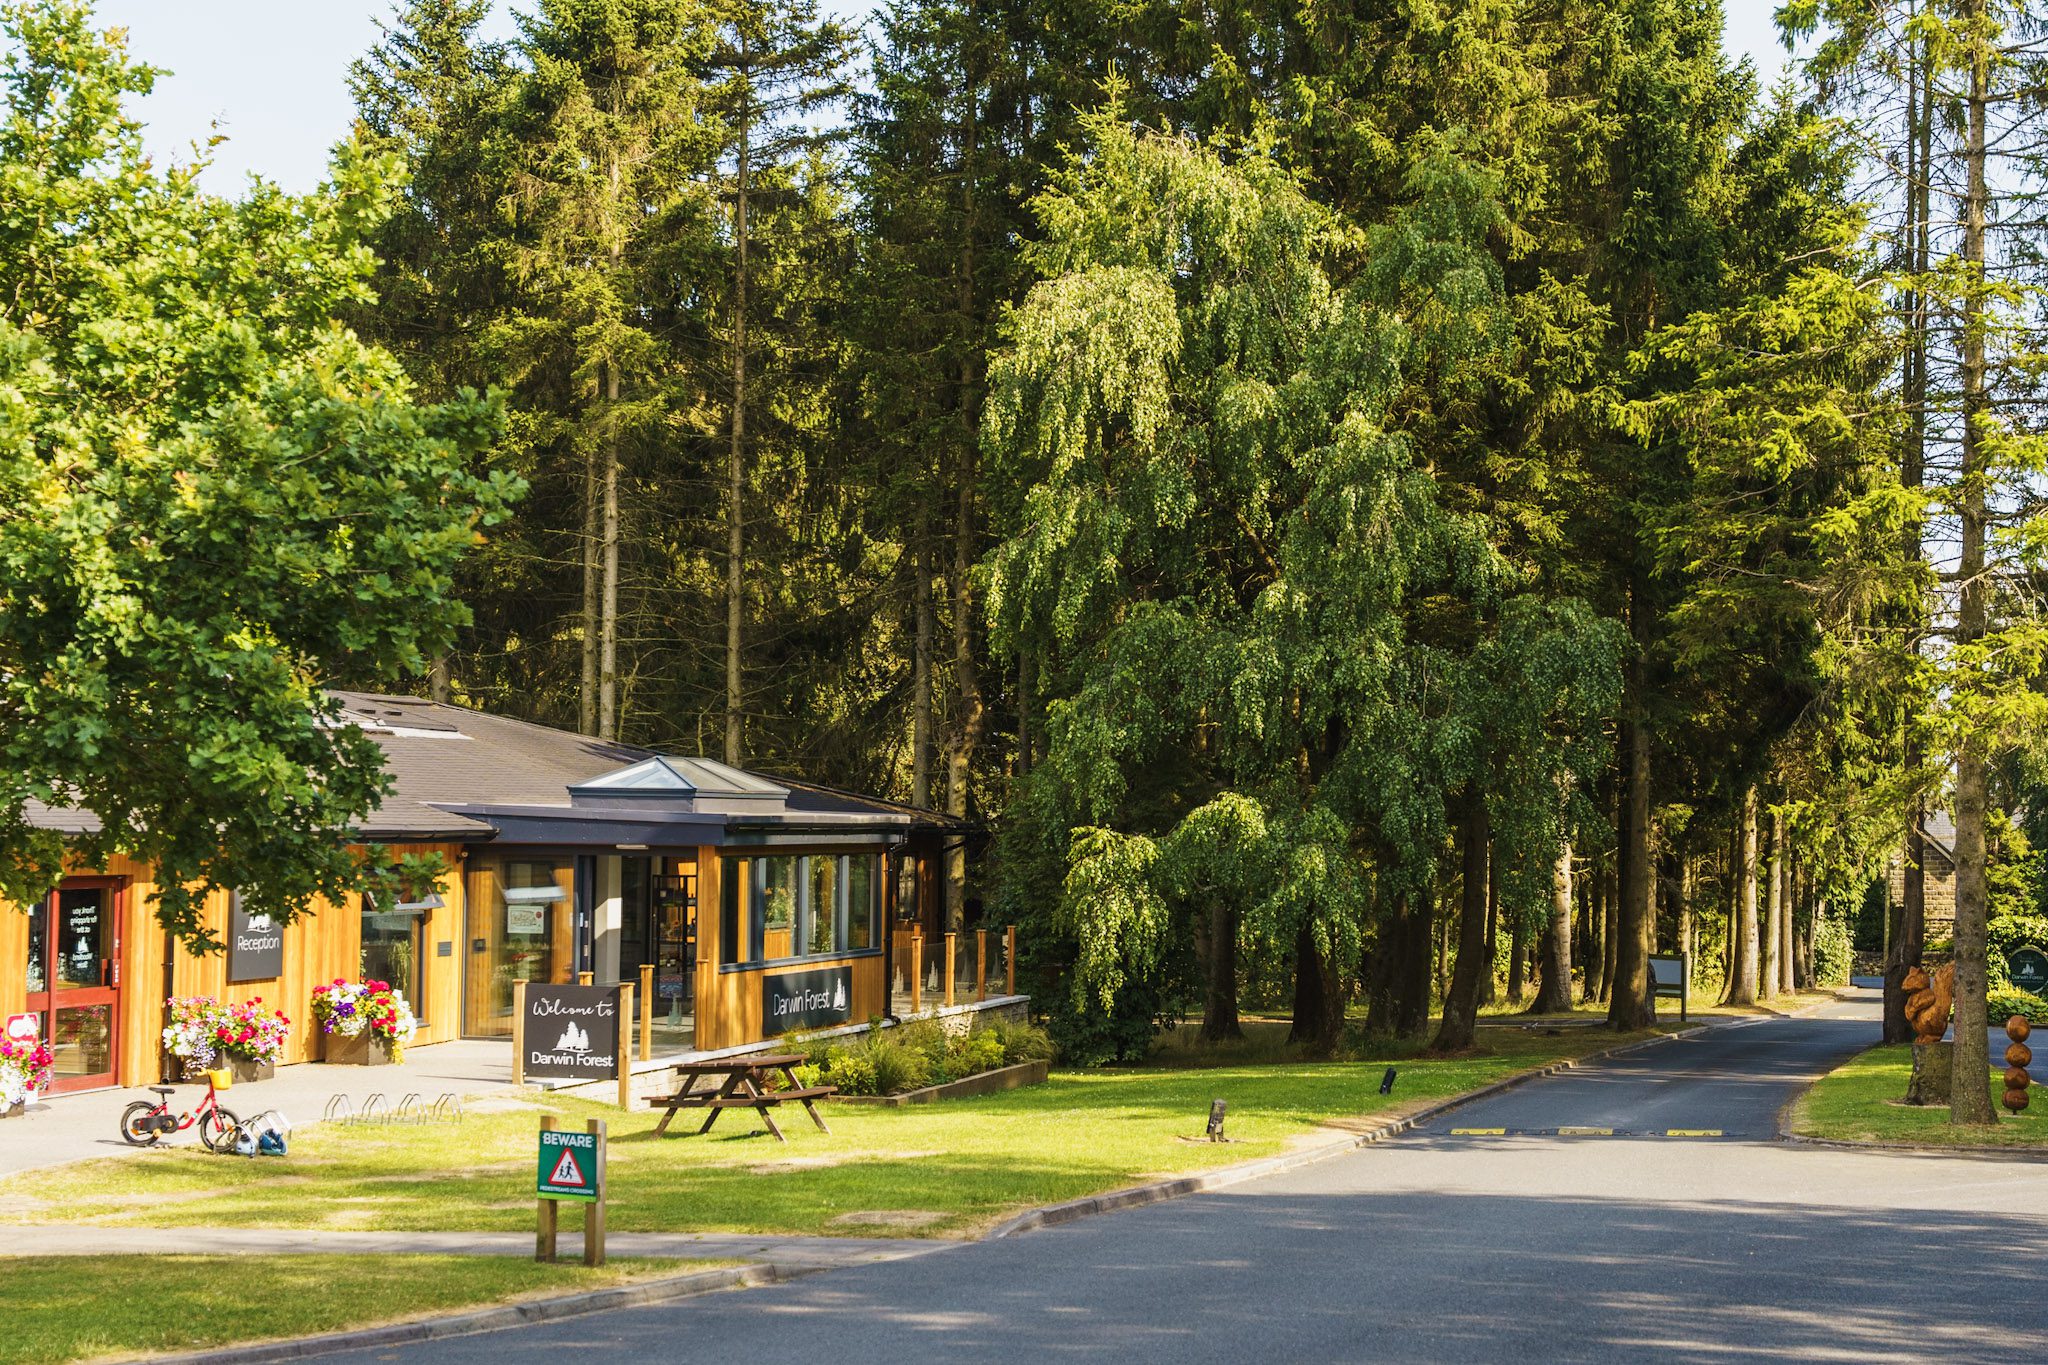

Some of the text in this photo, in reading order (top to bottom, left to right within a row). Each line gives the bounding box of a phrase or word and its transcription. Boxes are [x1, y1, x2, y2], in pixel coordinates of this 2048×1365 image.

[237, 933, 280, 954] Reception
[532, 997, 615, 1017] Welcome to
[773, 988, 831, 1016] Darwin Forest
[531, 1051, 614, 1067] Darwin Forest
[543, 1132, 592, 1148] BEWARE
